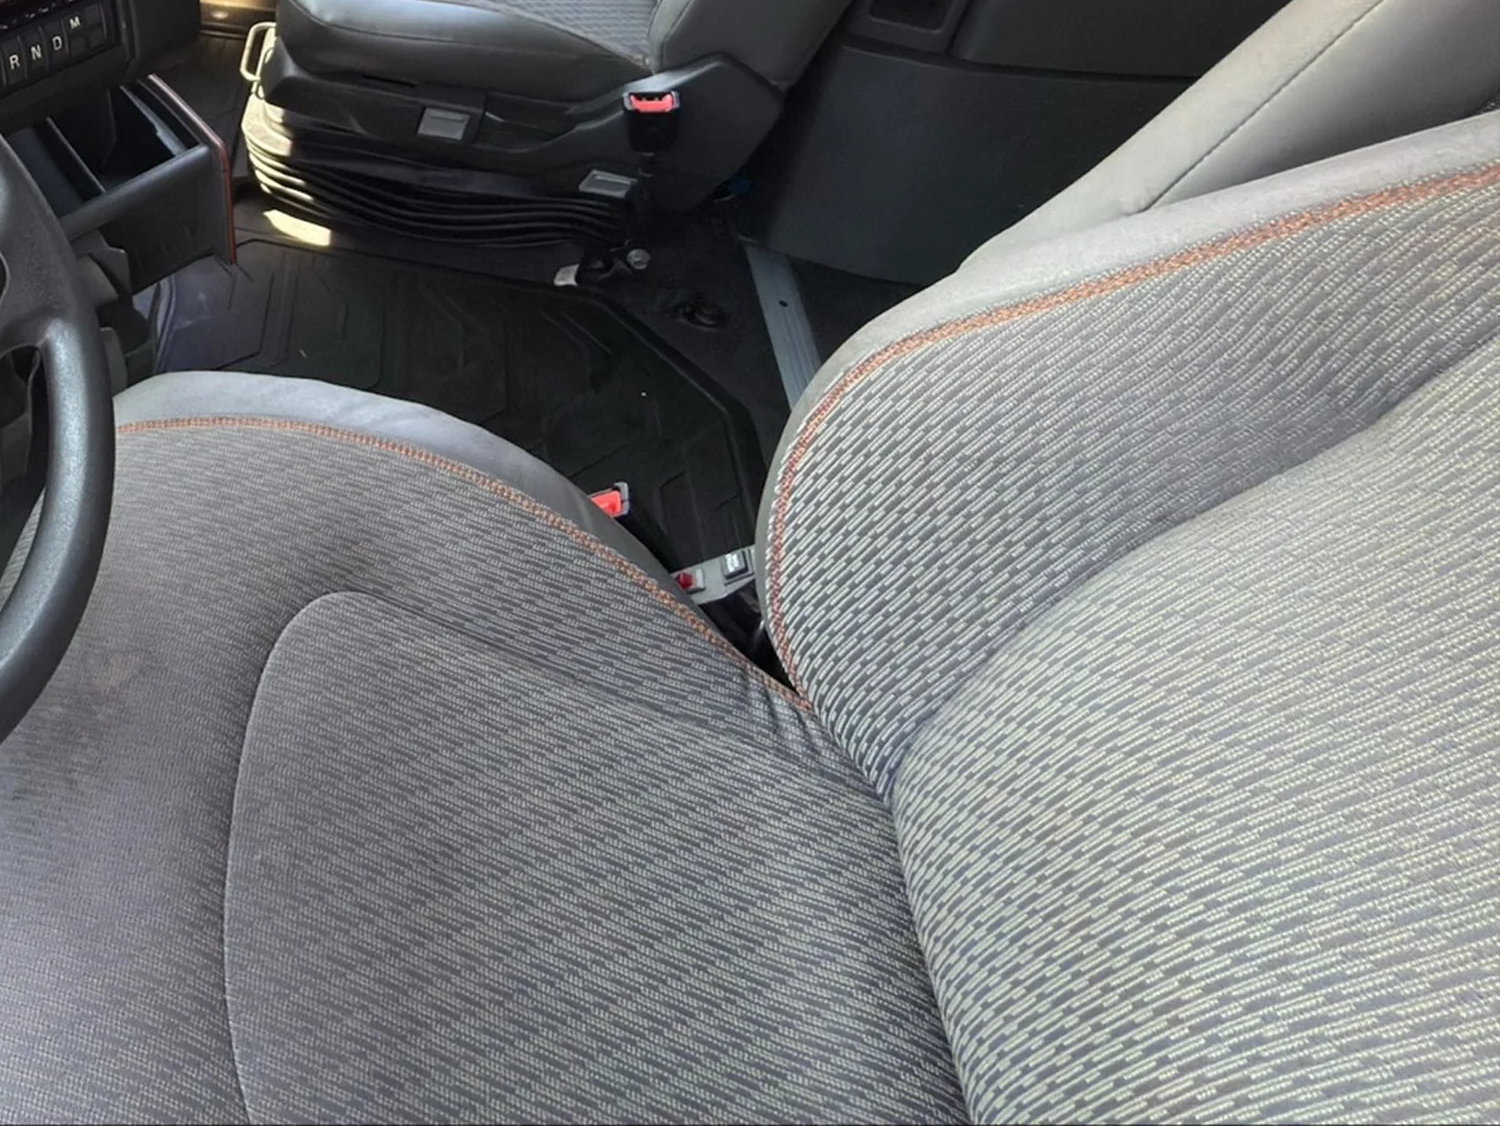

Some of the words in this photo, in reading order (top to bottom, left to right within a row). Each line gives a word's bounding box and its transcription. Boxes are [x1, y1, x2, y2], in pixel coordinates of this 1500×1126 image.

[9, 54, 21, 70] R
[30, 44, 42, 61] N
[52, 35, 63, 51] D
[69, 16, 81, 29] M
